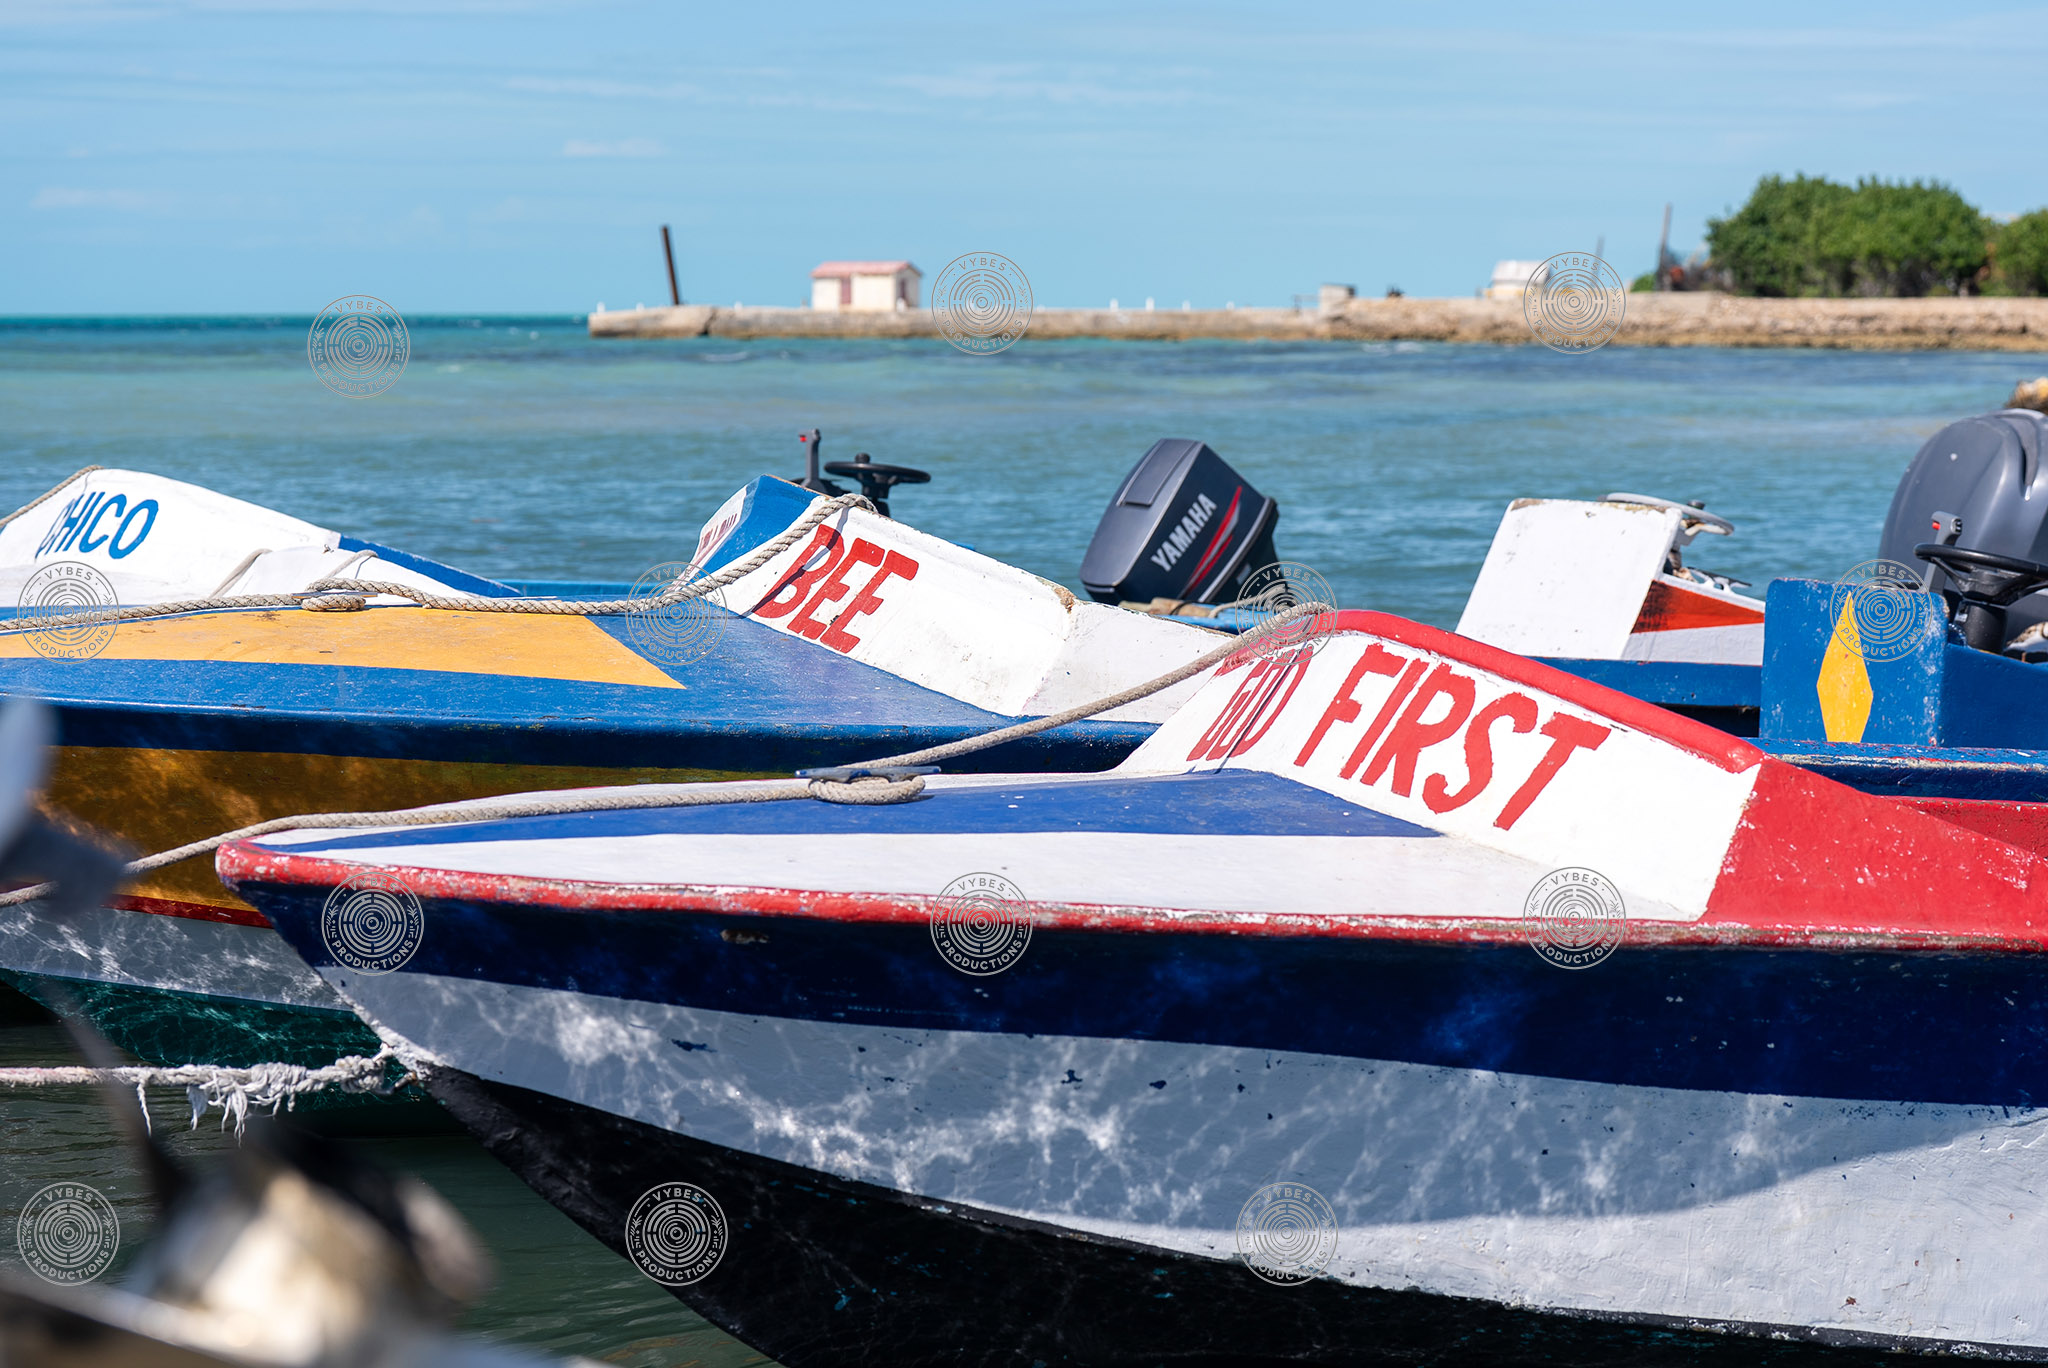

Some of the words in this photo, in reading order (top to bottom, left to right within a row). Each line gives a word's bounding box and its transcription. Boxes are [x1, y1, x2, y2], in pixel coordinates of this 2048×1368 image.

[748, 524, 919, 653] BEE
[1151, 493, 1217, 572] YAMAHA
[1186, 646, 1314, 761] GOD
[1293, 643, 1611, 831] FIRST
